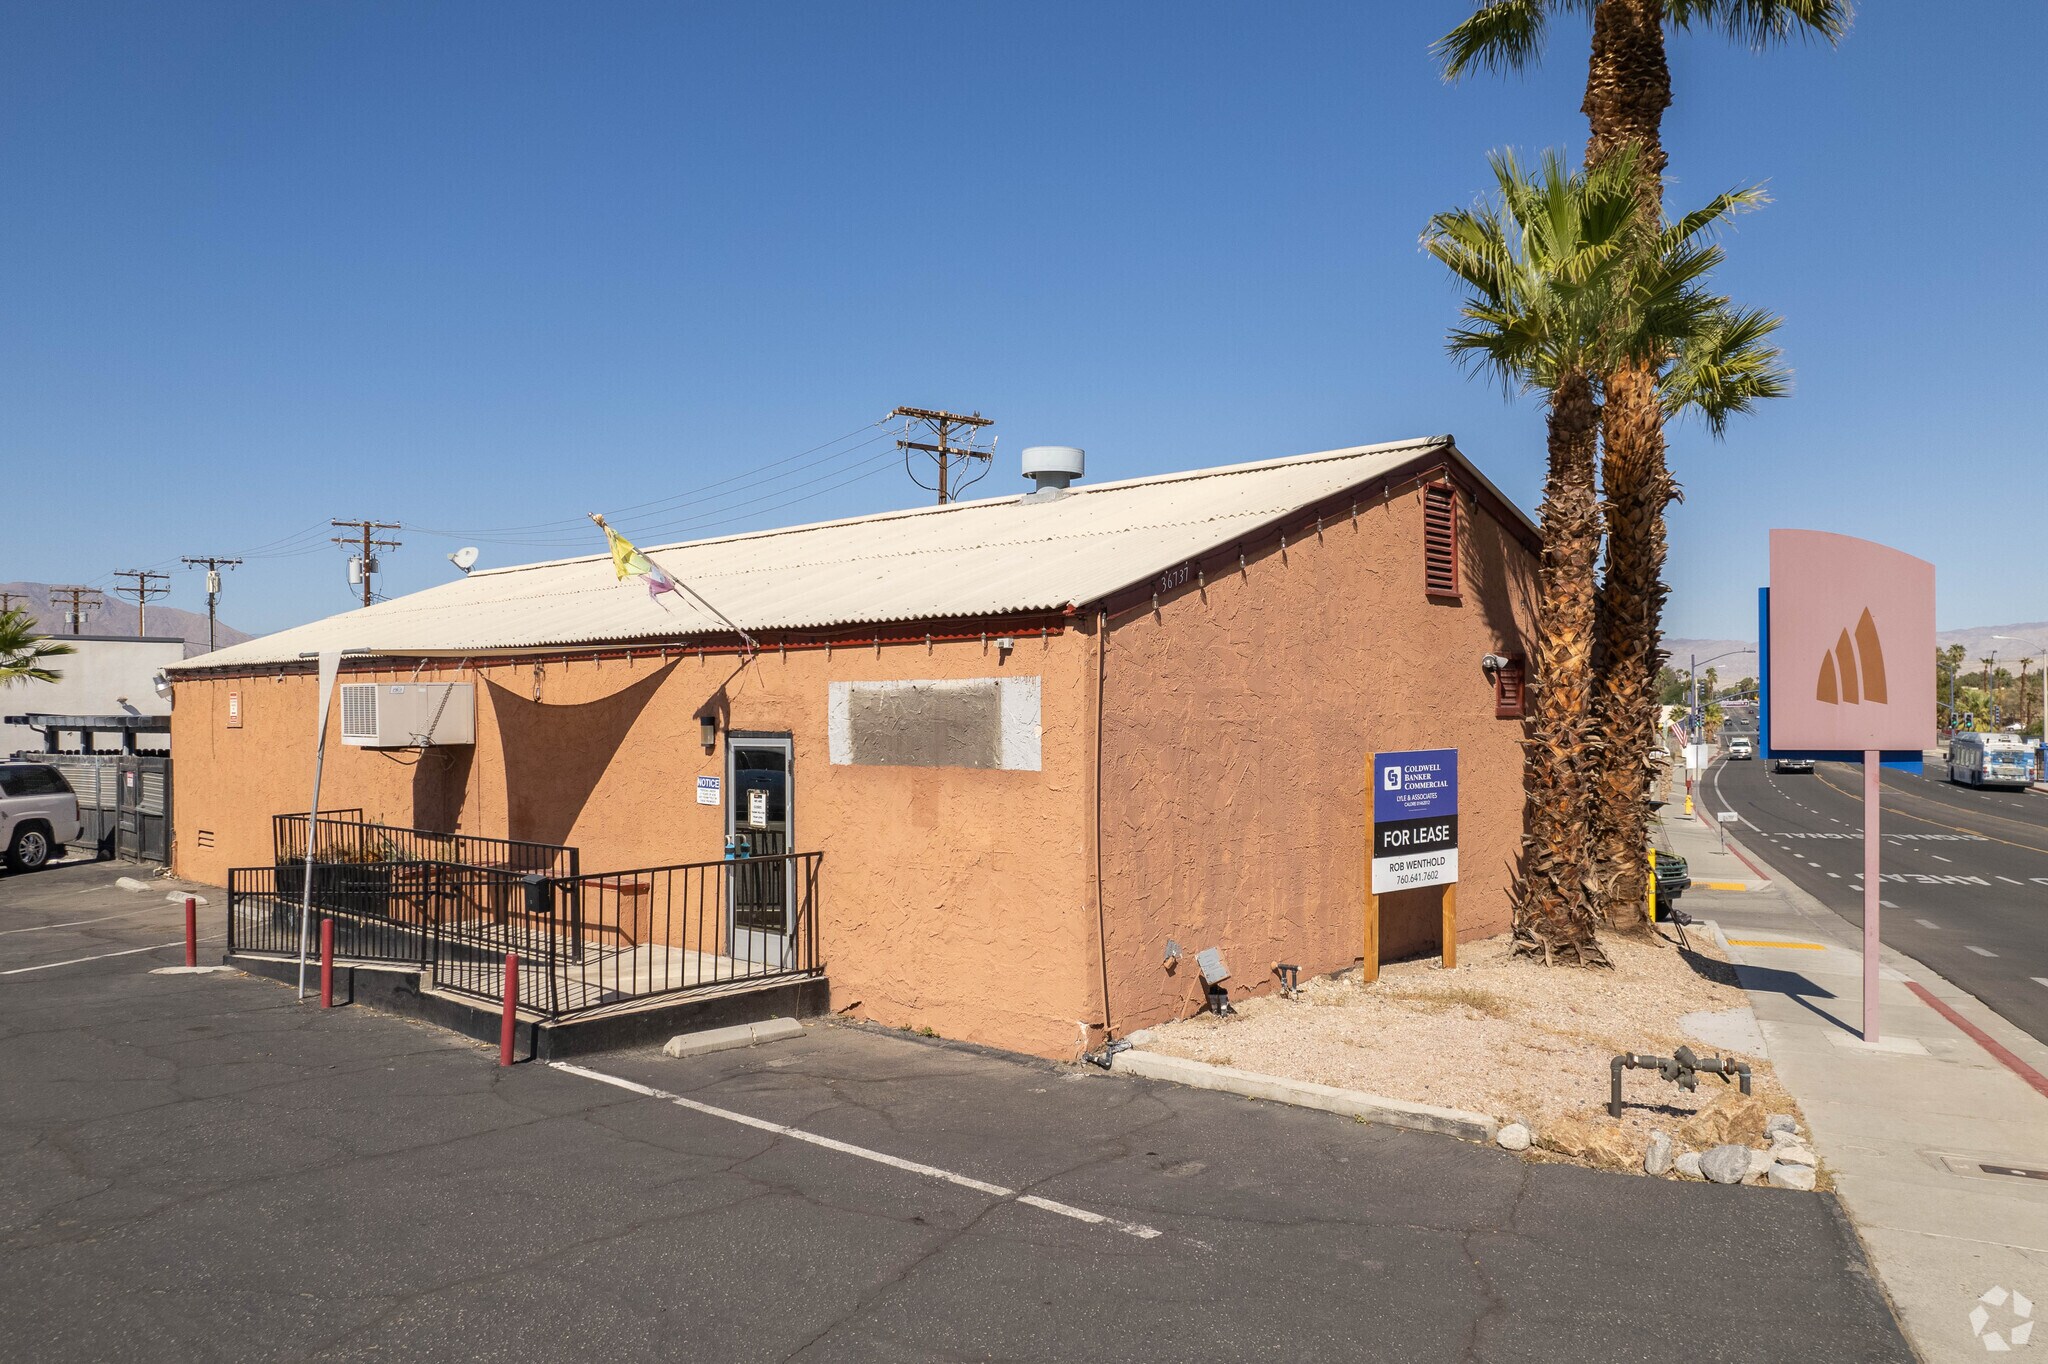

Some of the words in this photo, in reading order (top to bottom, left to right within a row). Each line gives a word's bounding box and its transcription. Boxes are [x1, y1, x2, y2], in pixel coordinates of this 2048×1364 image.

[1161, 566, 1189, 593] 36737
[1404, 764, 1441, 773] COLDWELL
[1404, 773, 1431, 781] BANKER
[697, 778, 720, 788] NOTICE
[1404, 780, 1448, 790] COMMERCIAL
[1411, 792, 1438, 801] ASSOCIATES
[1384, 829, 1410, 848] FOR
[1413, 825, 1450, 844] LEASE
[1389, 862, 1405, 872] ROB
[1406, 857, 1446, 870] WENTHOLD
[1397, 870, 1439, 885] 760.641.7602
